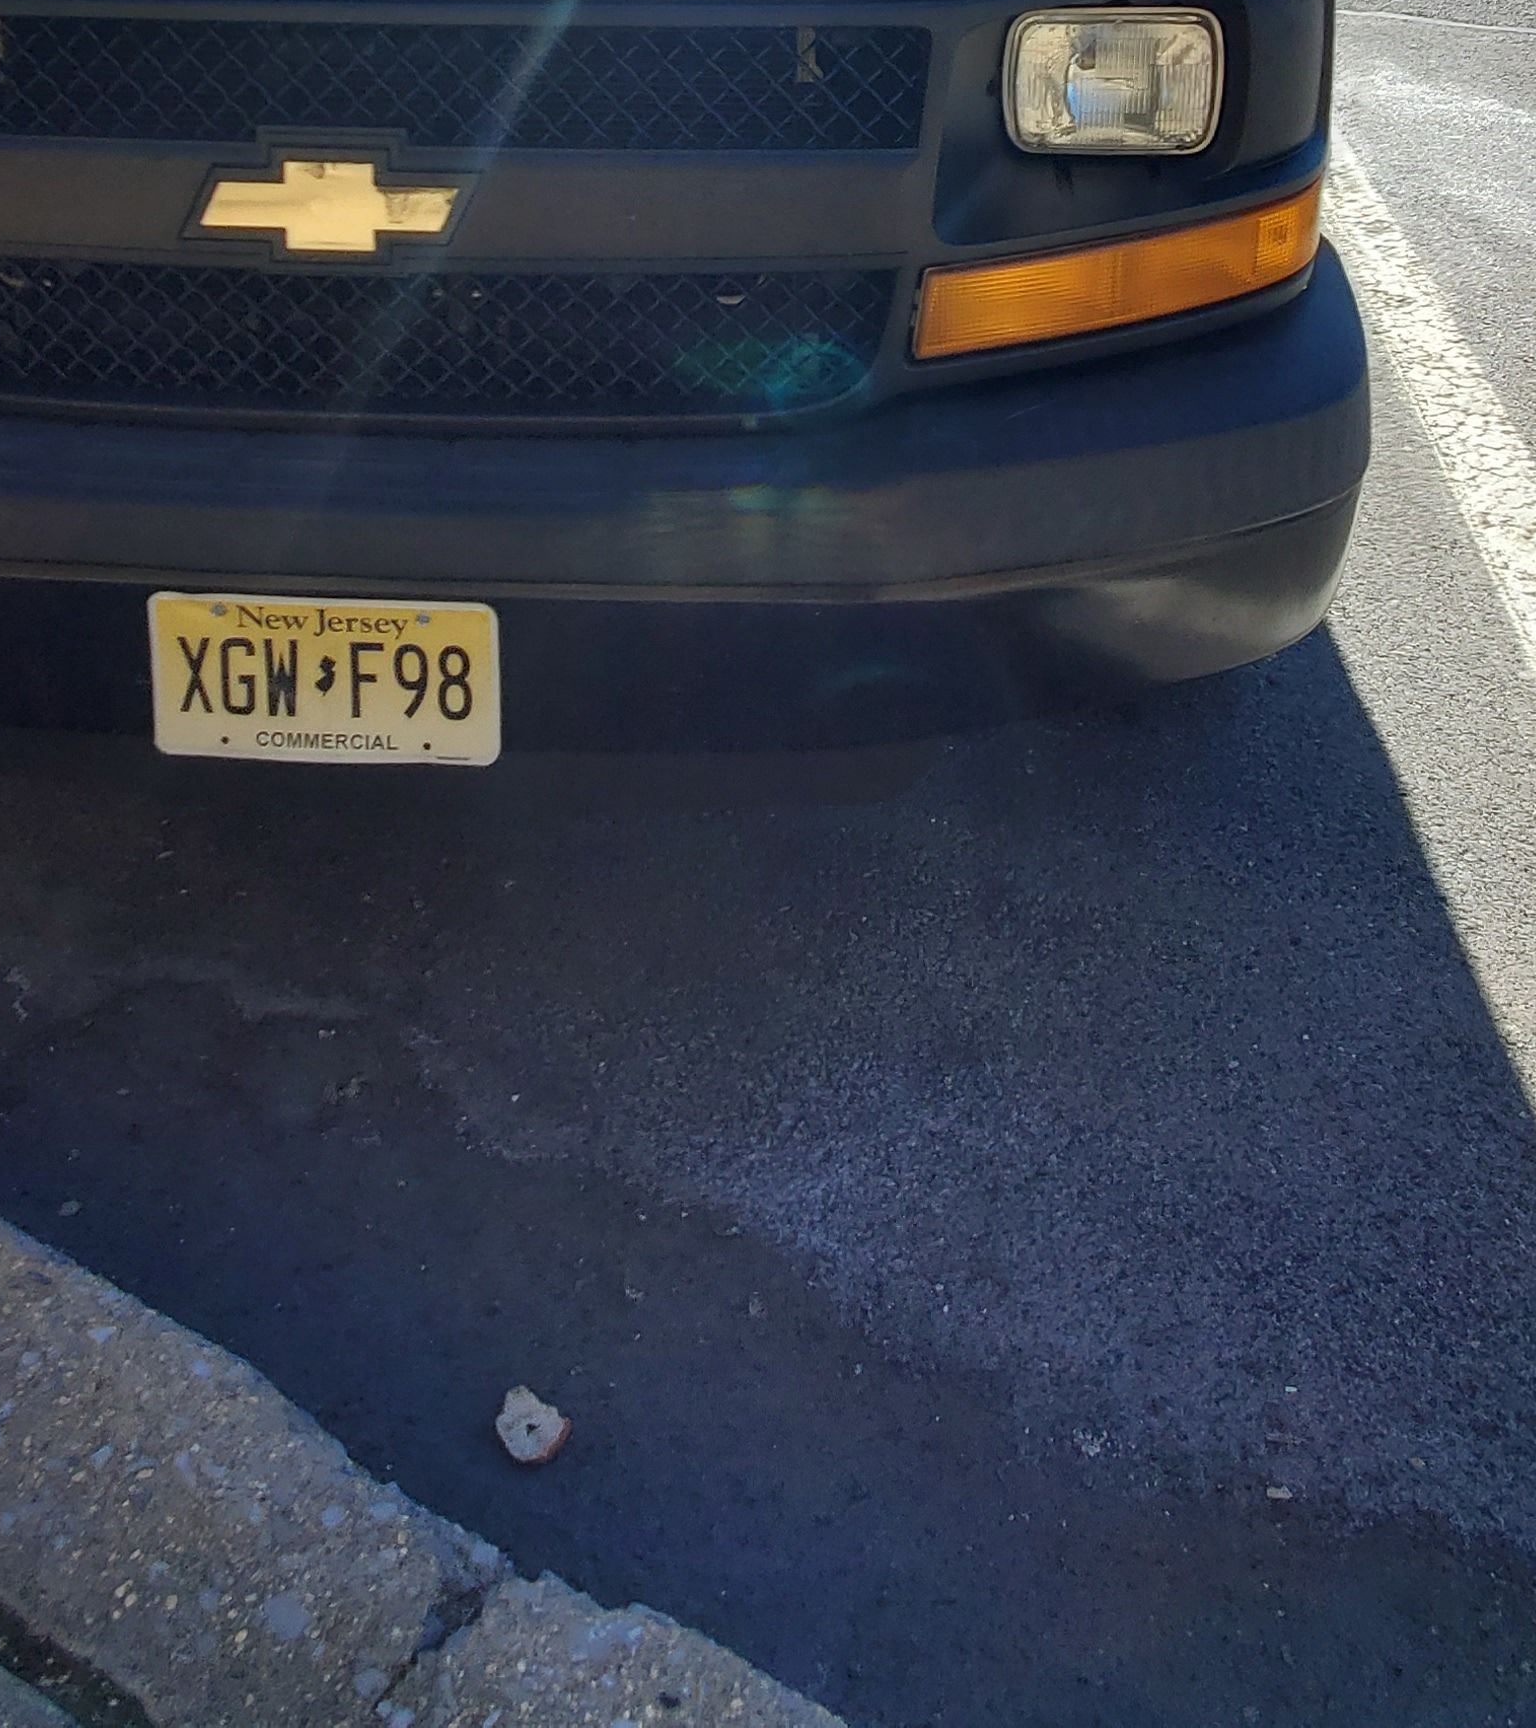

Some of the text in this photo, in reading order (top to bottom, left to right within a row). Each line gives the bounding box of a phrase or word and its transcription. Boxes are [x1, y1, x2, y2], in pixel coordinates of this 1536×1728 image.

[235, 604, 409, 640] New Jersey
[176, 635, 474, 721] XGW F98
[255, 730, 400, 752] COMMERCIAL
